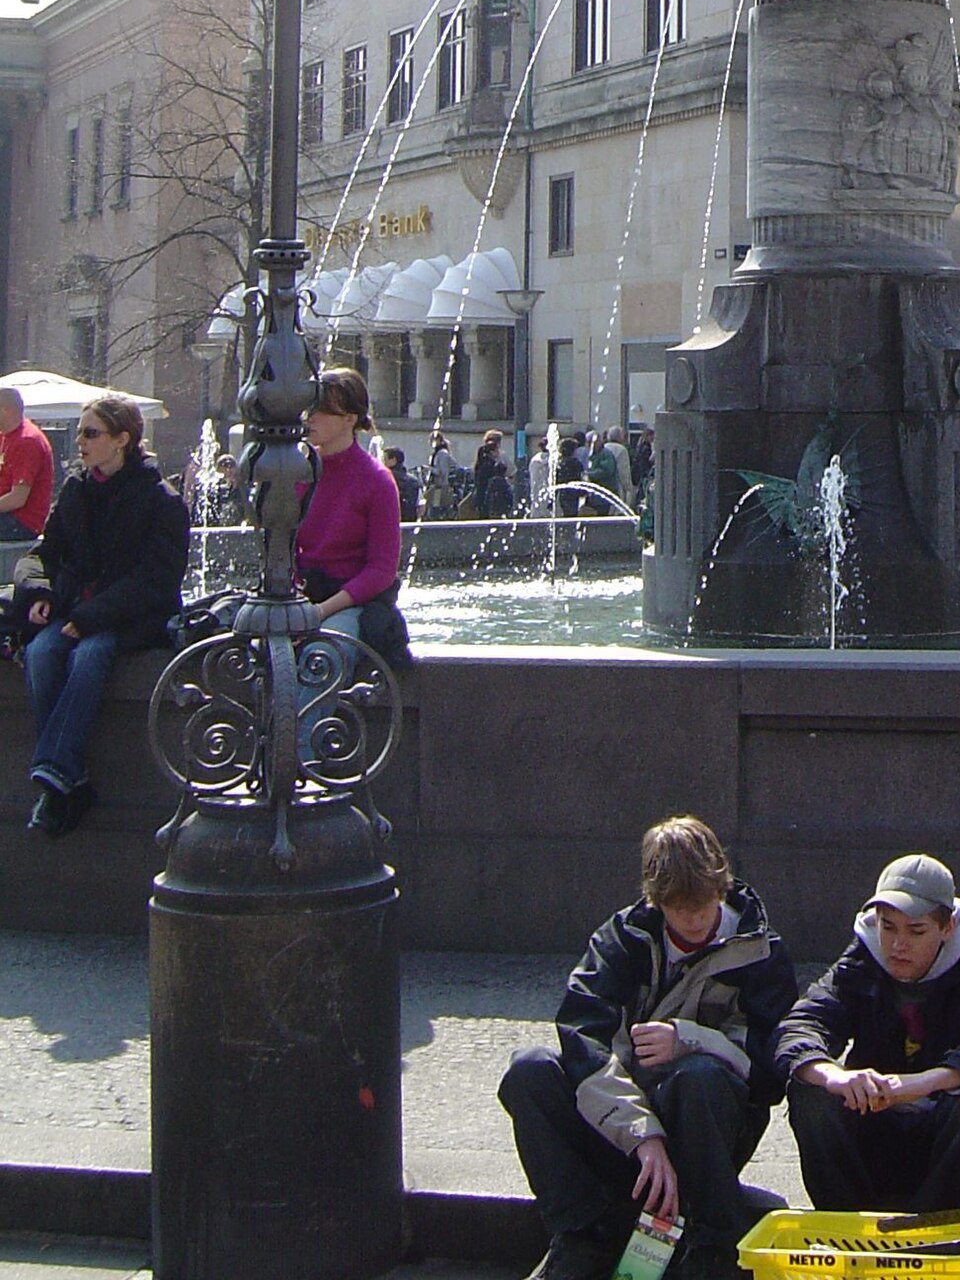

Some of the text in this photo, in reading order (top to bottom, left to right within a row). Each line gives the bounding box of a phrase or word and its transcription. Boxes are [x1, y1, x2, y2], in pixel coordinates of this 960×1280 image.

[379, 205, 429, 238] Bank
[789, 1254, 836, 1266] NETTO
[876, 1256, 923, 1269] NETTO
